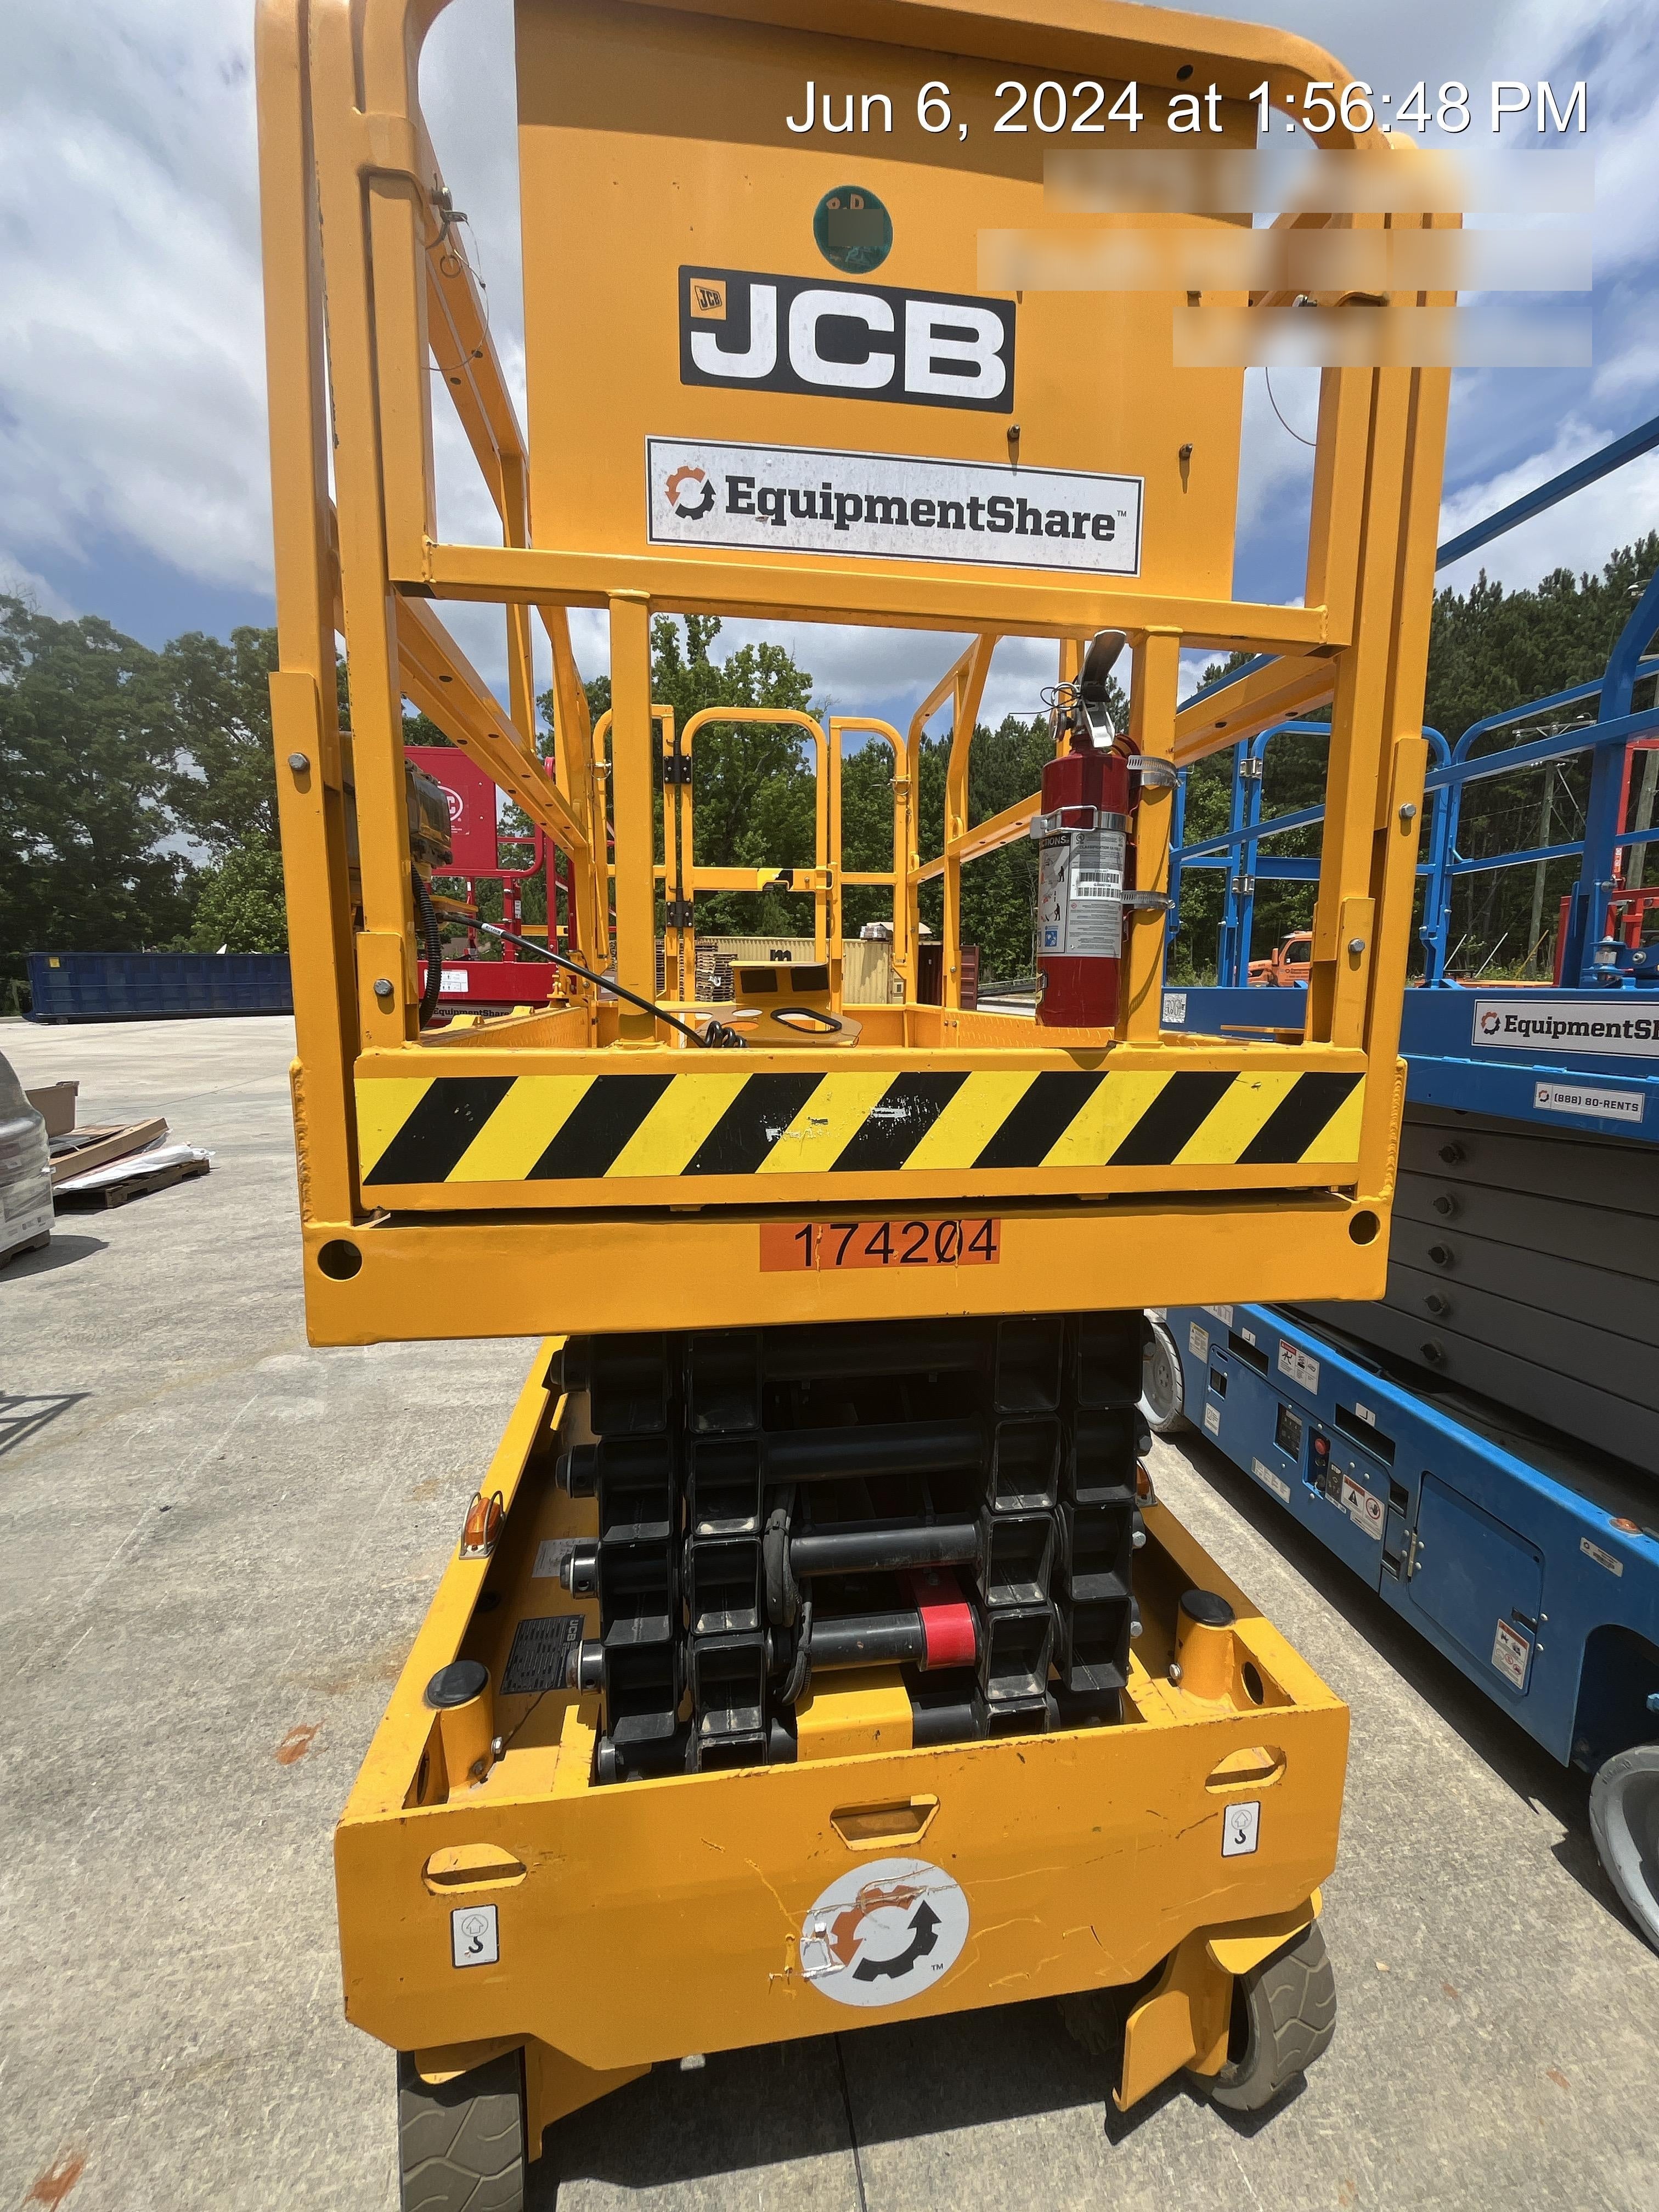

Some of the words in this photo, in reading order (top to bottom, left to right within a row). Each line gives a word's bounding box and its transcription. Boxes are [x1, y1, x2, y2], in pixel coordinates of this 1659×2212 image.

[699, 288, 721, 308] JCB
[691, 283, 1006, 399] JCB
[725, 475, 1116, 543] EquipmentShare
[1554, 1093, 1582, 1106] (888)
[1585, 1098, 1639, 1112] 80-RENTS
[794, 1218, 997, 1267] 174204
[566, 1619, 579, 1642] JCB
